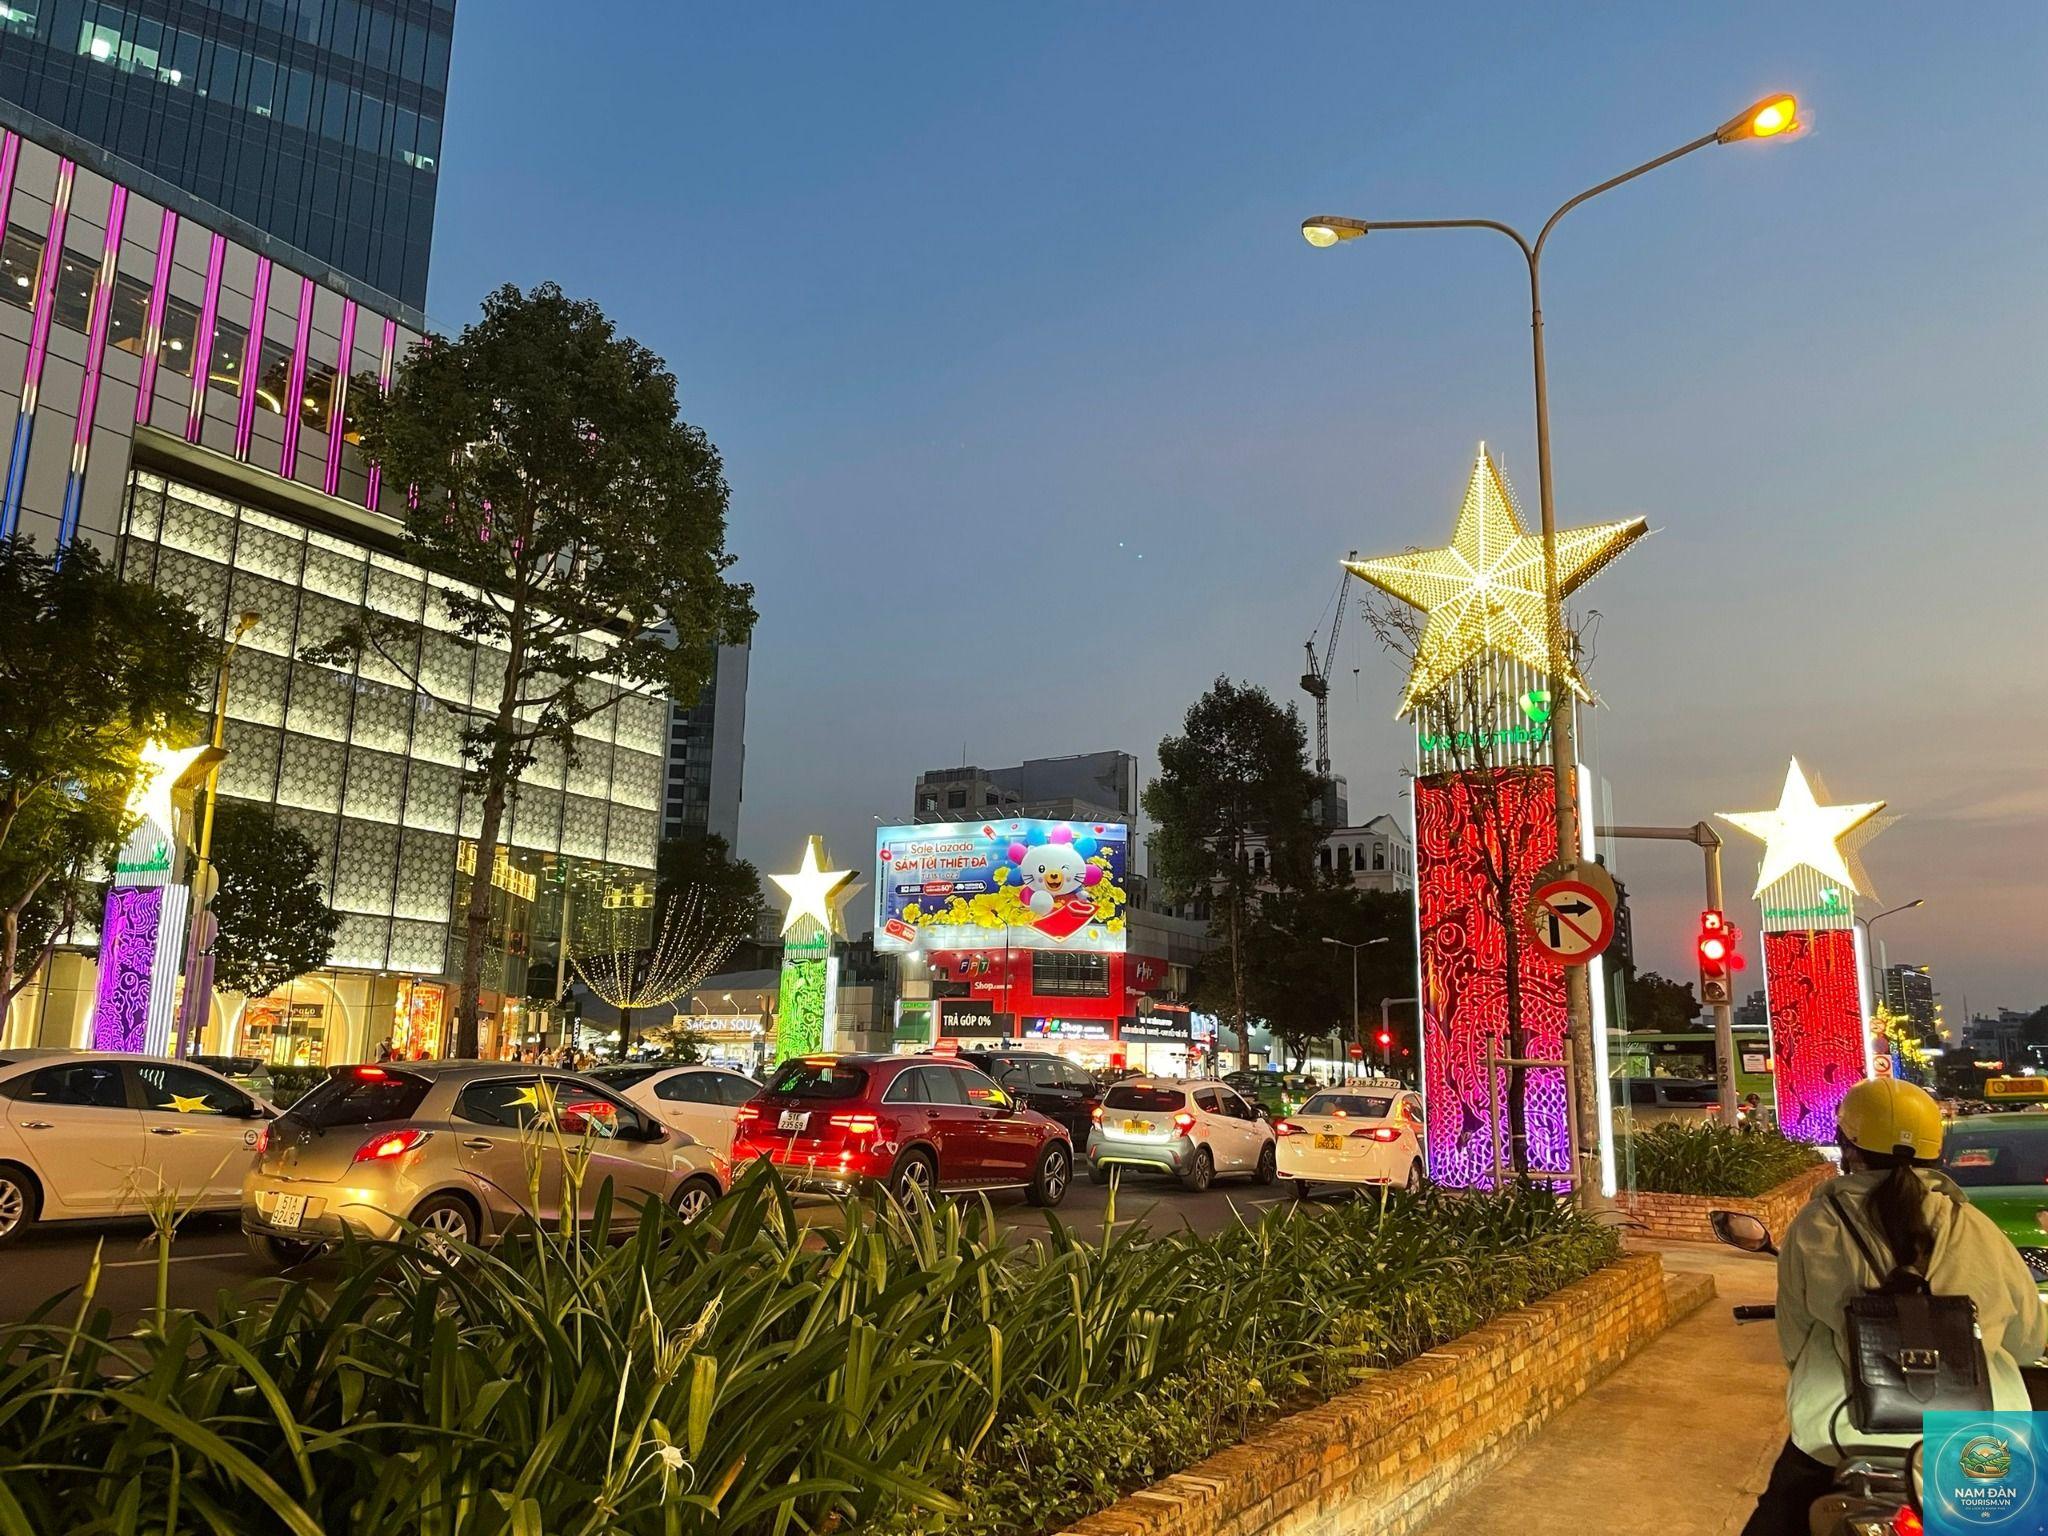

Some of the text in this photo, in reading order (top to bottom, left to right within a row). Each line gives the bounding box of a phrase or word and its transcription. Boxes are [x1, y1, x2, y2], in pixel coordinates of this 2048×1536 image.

[911, 842, 973, 854] Sale Lazada
[960, 959, 989, 974] FPT
[686, 1019, 761, 1030] SAIGON SQUA
[943, 1012, 991, 1026] TRẢ GÓP 0%
